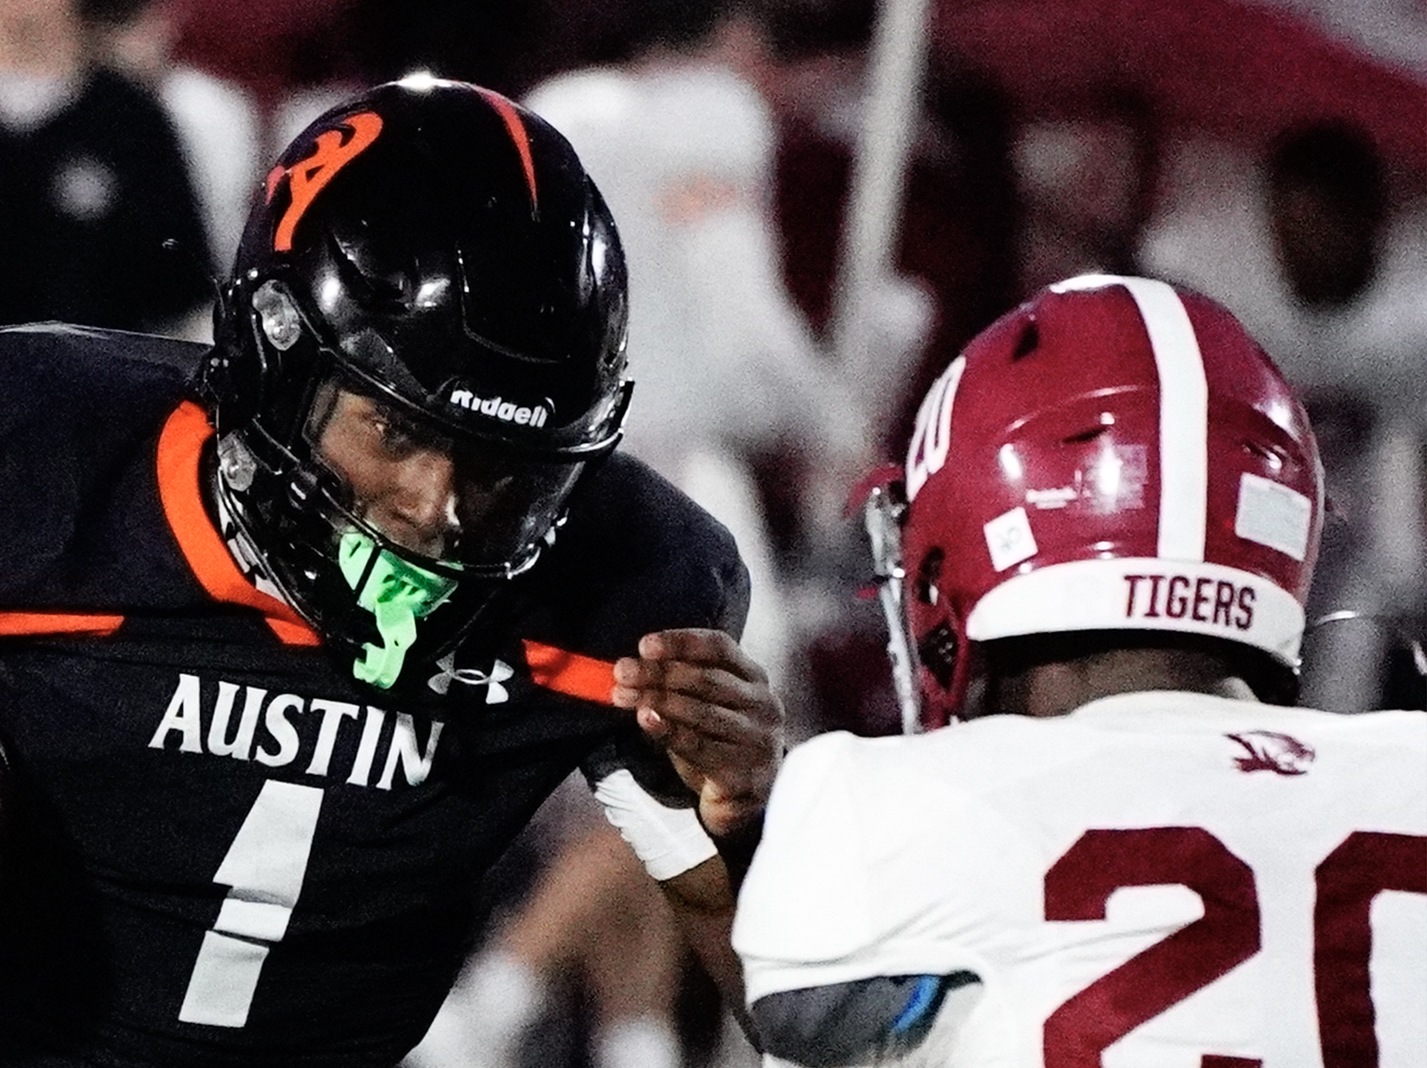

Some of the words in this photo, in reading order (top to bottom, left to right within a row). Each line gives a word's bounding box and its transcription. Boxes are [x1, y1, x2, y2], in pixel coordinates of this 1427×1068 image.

[1123, 574, 1256, 630] TIGERS
[148, 673, 445, 790] AUSTIN
[178, 779, 324, 1028] 1
